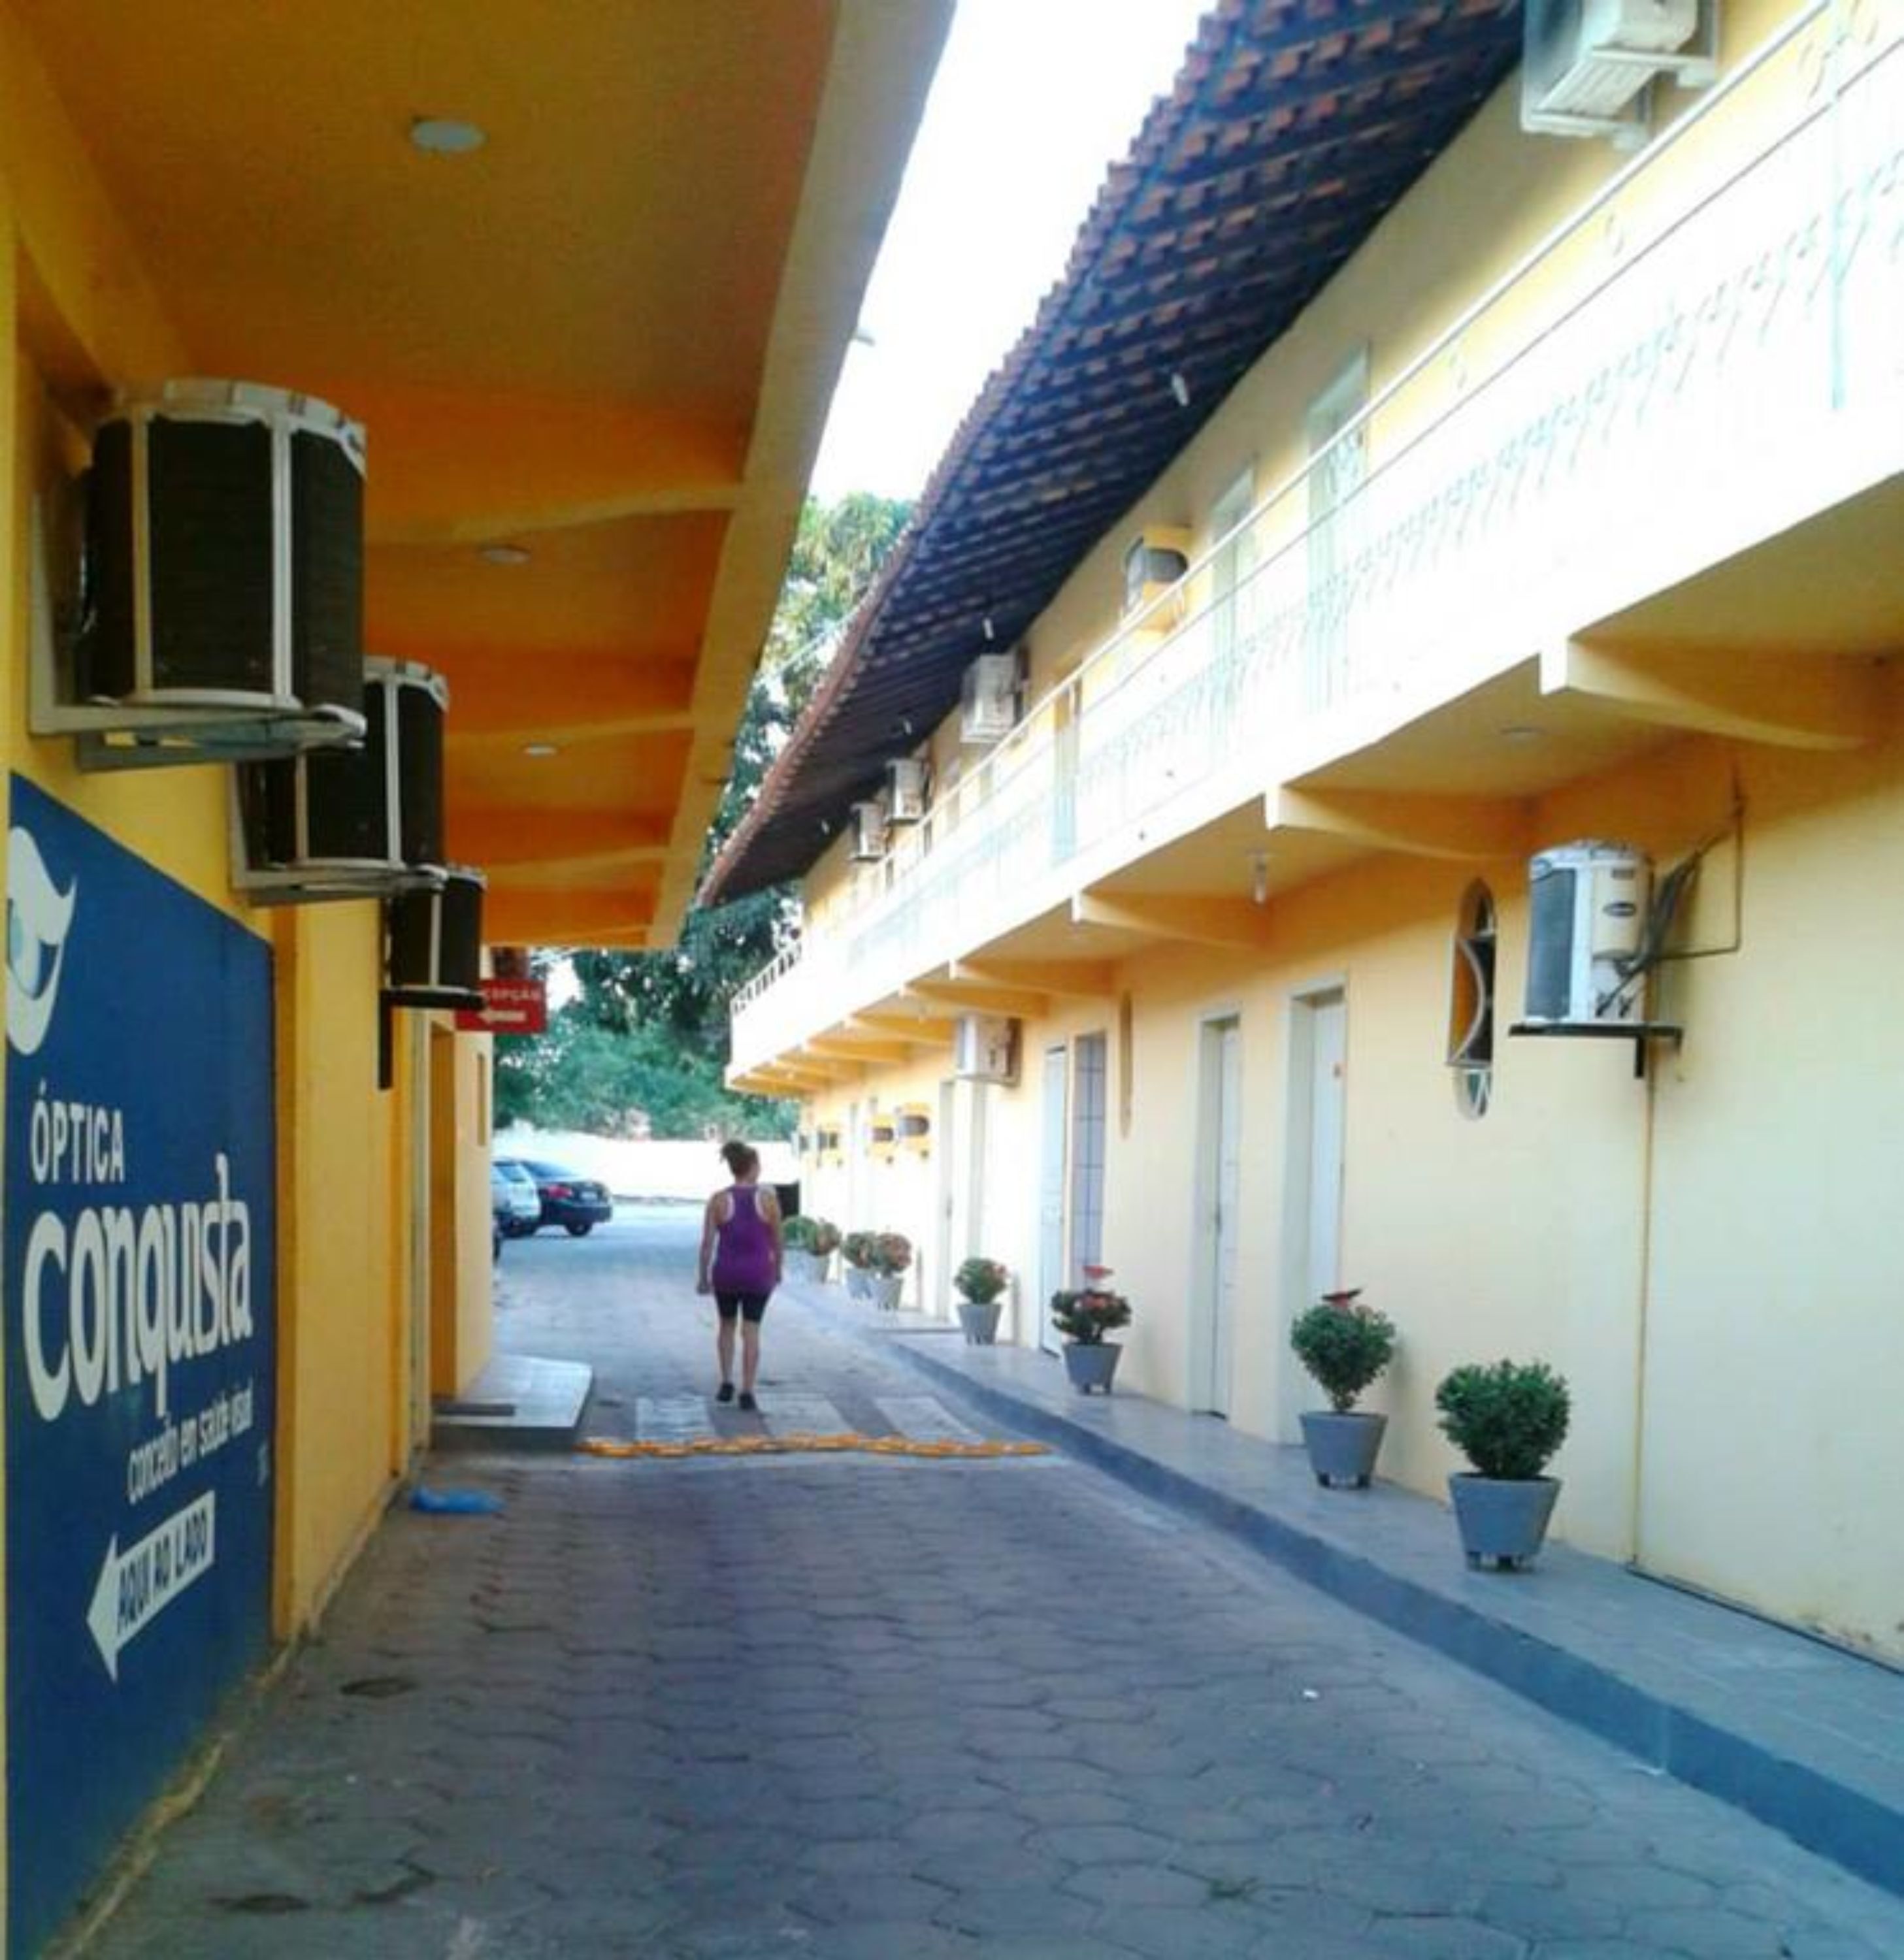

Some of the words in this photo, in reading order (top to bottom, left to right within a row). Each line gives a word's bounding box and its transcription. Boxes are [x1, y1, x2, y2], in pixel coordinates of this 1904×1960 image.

[31, 1078, 126, 1184] ÓPTICA
[116, 1544, 152, 1636] AQUI
[154, 1533, 172, 1593] AO
[175, 1506, 208, 1581] LADO
